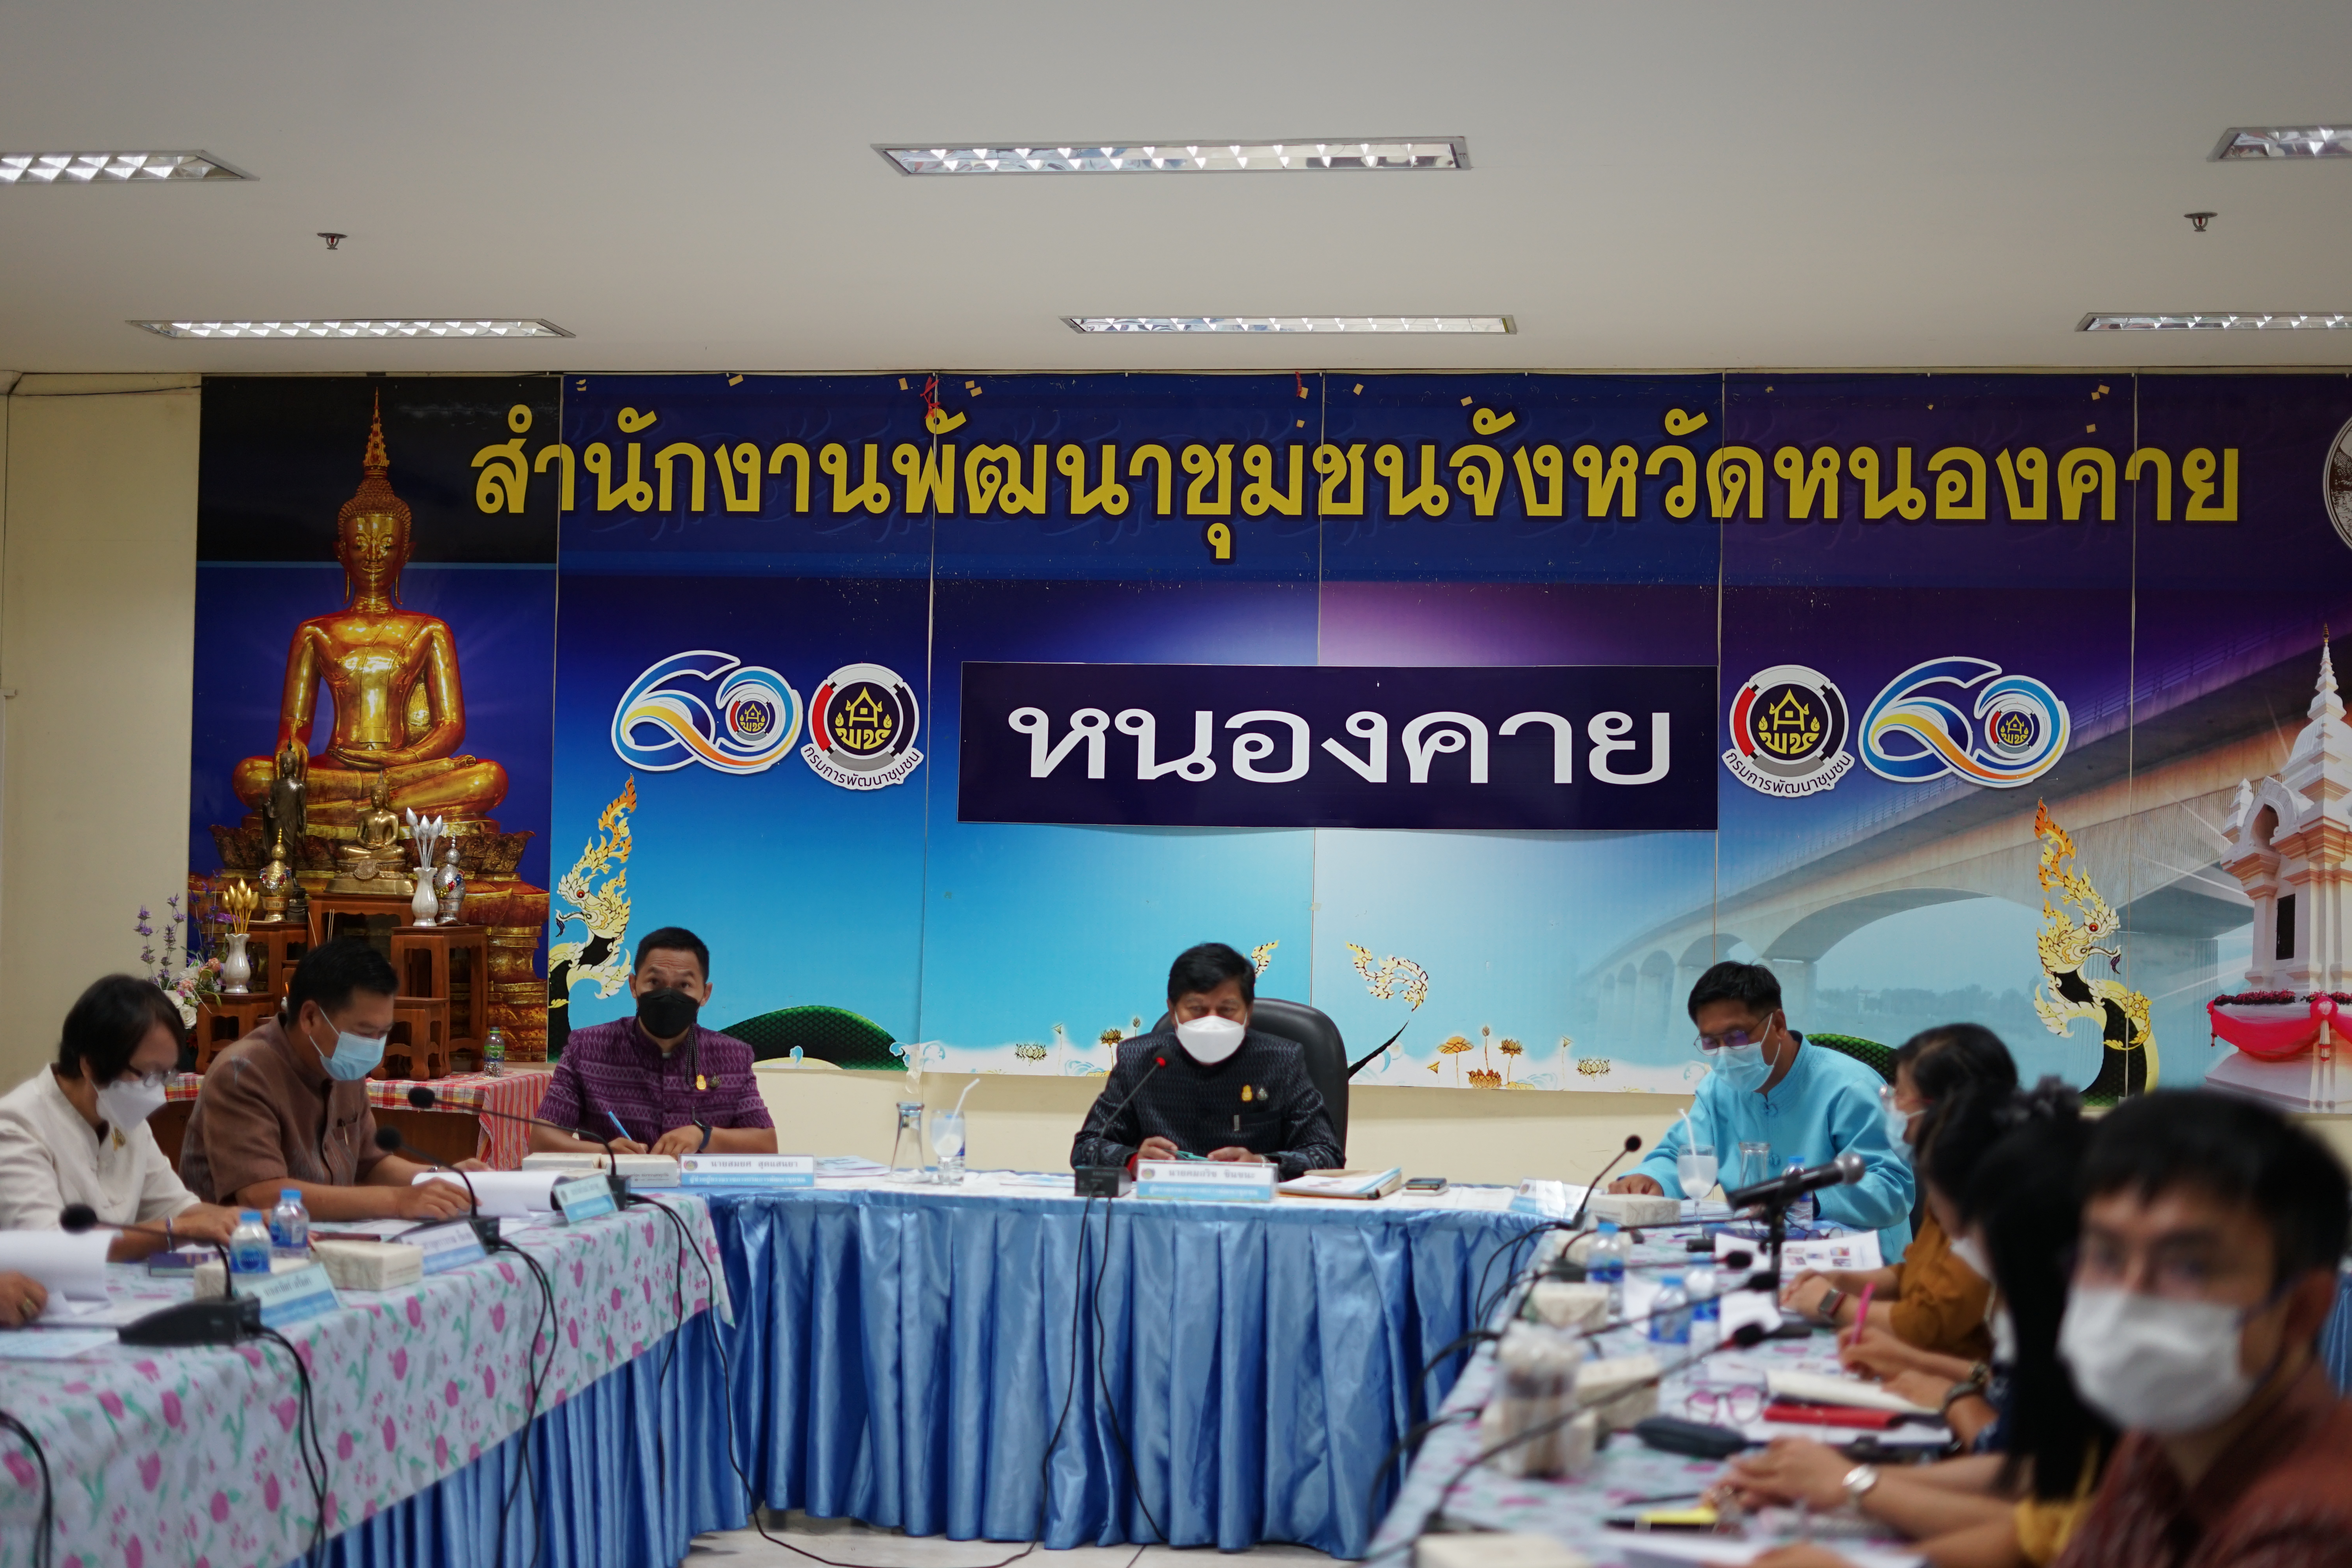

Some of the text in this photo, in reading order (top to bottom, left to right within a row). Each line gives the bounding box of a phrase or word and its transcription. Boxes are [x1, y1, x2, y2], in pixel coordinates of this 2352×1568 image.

[472, 405, 2238, 559] สำนักงานพัฒนาชุมชนจังหวัดหนองคาย
[804, 747, 920, 787] กรมการพัฒนาชุมชน
[1008, 707, 1670, 785] หนองคาย
[1726, 752, 1851, 793] กรมการพัฒนาชุมชน
